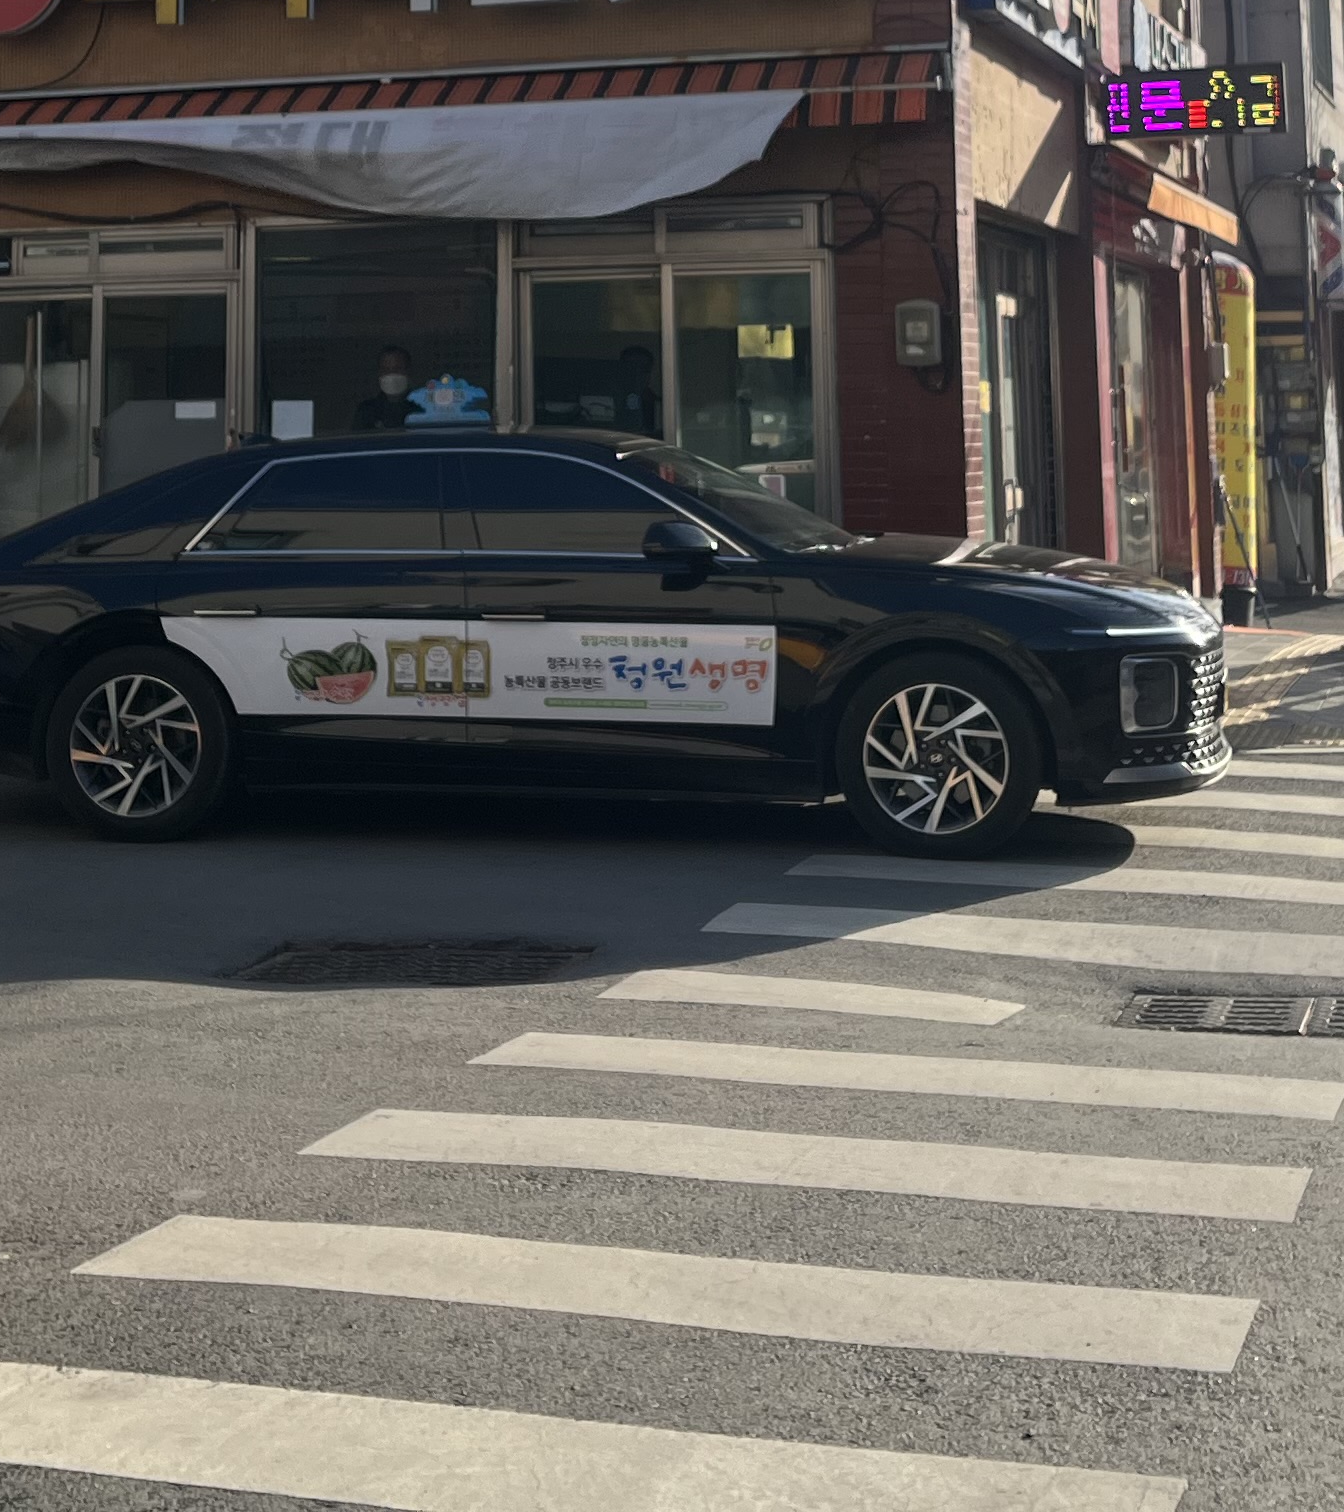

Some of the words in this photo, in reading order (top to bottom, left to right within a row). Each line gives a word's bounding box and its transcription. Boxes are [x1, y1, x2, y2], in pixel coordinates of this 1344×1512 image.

[546, 656, 579, 670] 청주시
[582, 657, 604, 670] 우수
[549, 675, 605, 691] 공동브랜드
